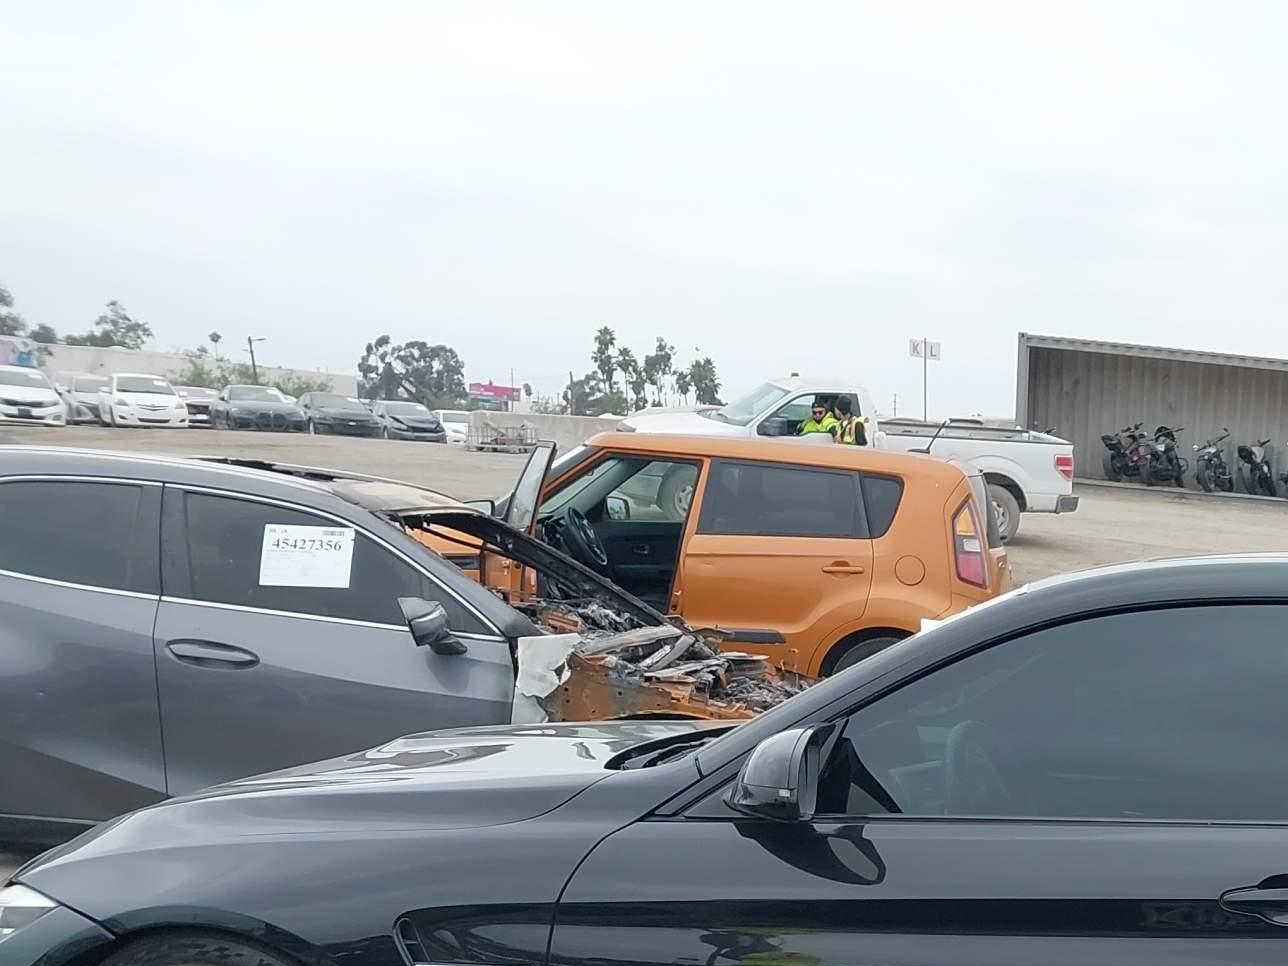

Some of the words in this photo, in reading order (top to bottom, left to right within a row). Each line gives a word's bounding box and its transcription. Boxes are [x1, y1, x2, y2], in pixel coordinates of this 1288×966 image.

[912, 342, 921, 355] K
[929, 343, 937, 357] L
[271, 537, 342, 552] 45427356
